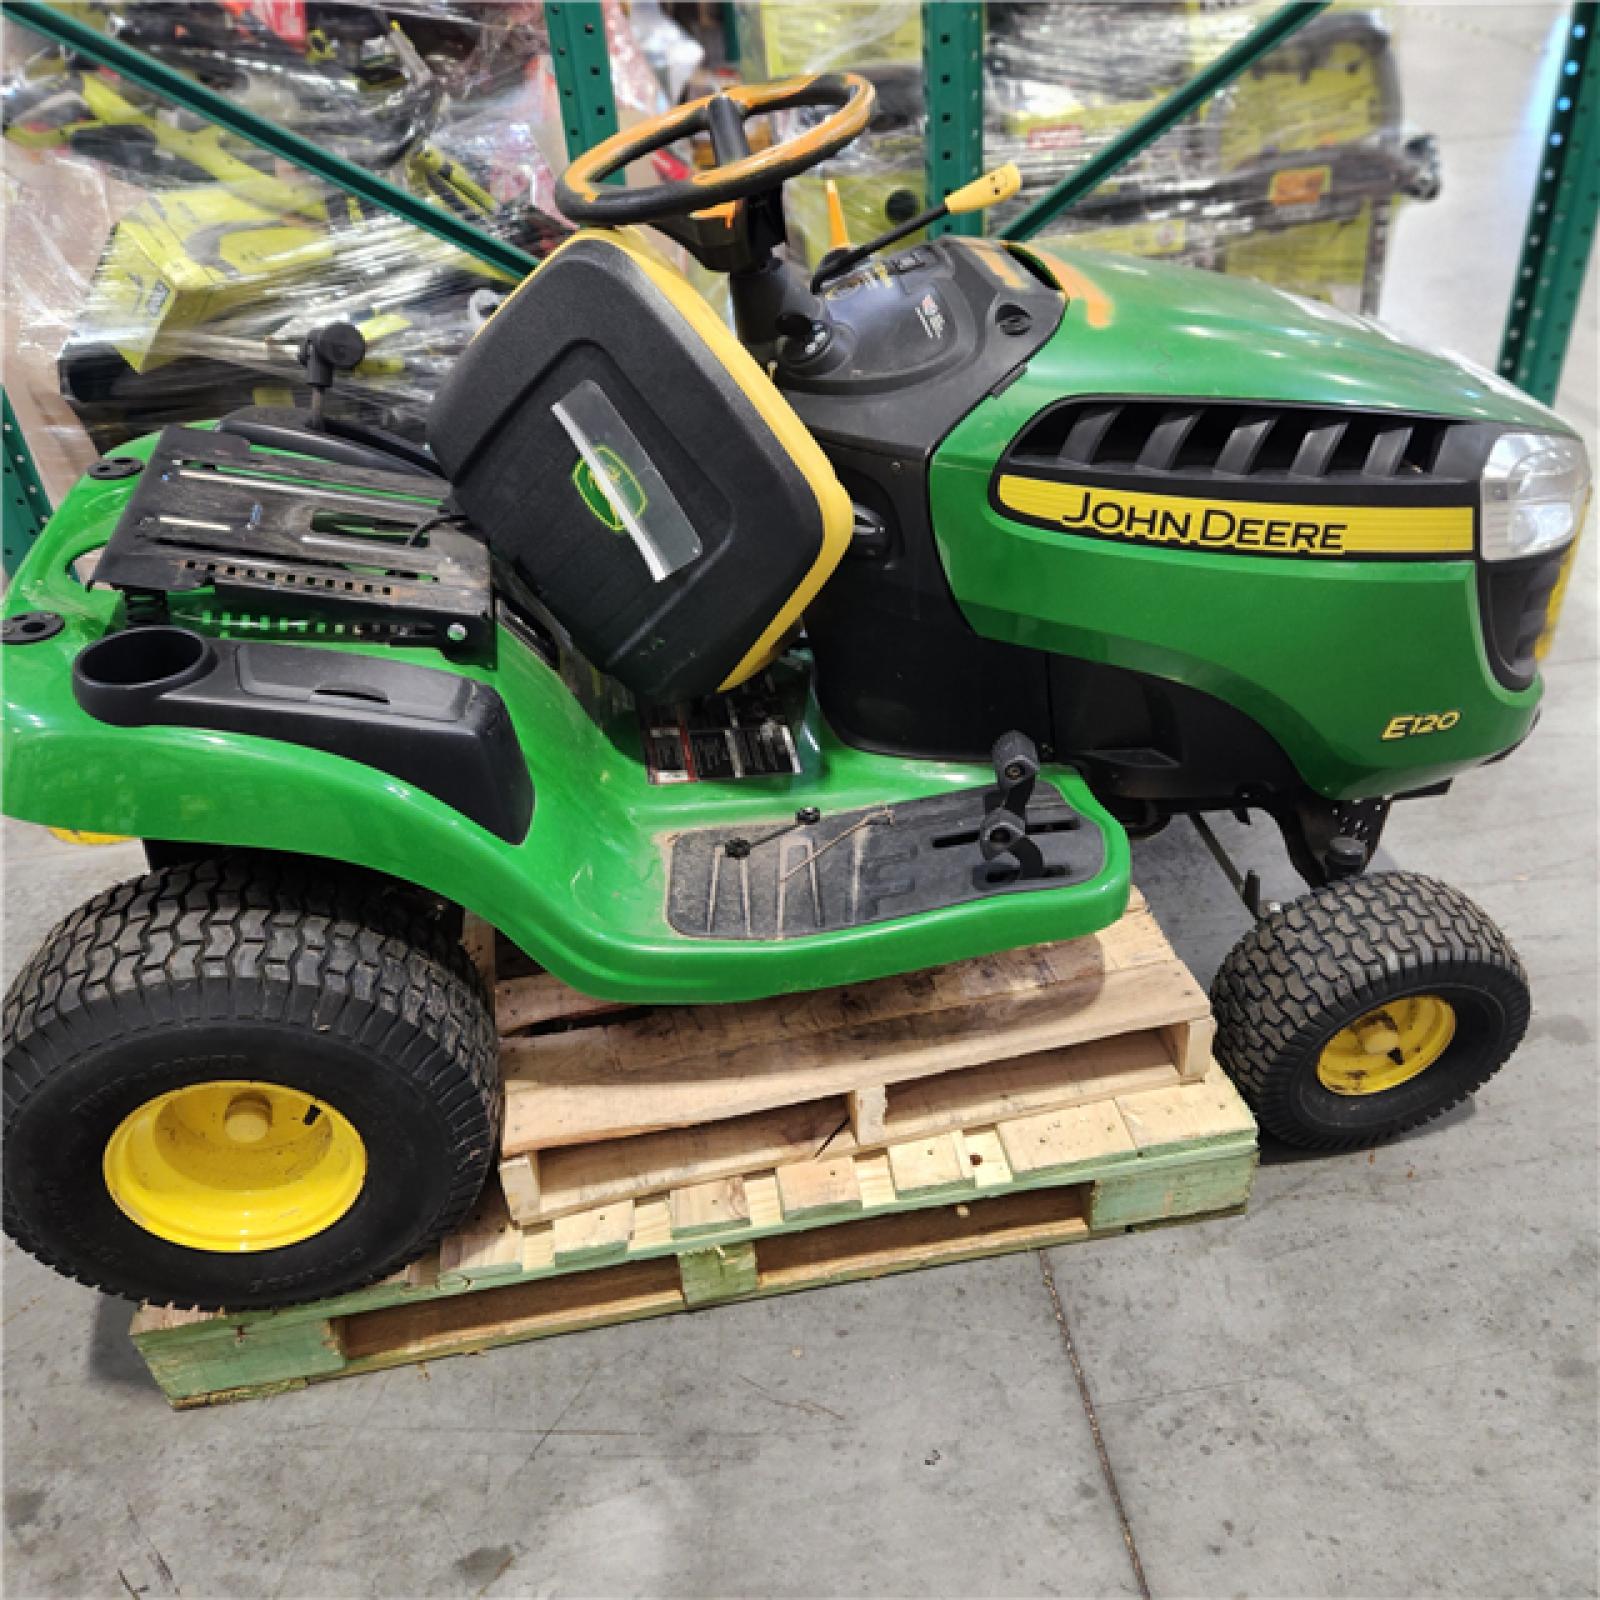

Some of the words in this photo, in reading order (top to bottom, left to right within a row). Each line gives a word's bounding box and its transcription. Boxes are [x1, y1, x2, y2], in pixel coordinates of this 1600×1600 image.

[1061, 491, 1193, 539] JOHN
[1200, 509, 1349, 552] DEERE
[1381, 711, 1461, 741] E120
